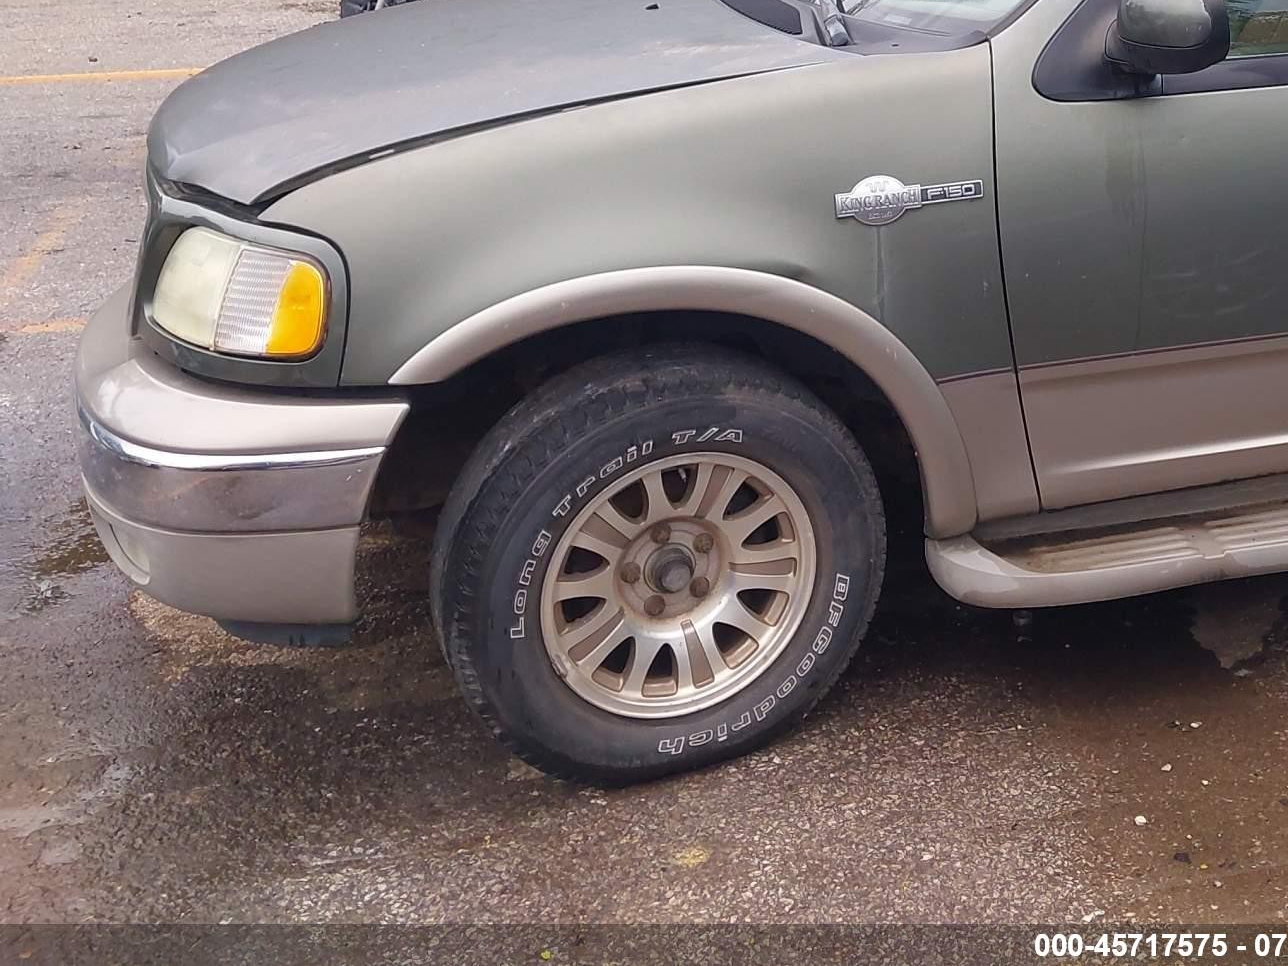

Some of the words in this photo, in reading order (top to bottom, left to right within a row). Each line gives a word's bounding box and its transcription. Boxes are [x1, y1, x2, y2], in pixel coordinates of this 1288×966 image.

[839, 194, 872, 212] KING
[872, 187, 919, 209] RANCH
[926, 183, 975, 201] F-150
[510, 529, 552, 639] Long
[552, 440, 653, 518] Trail
[671, 427, 744, 444] T/A
[657, 573, 850, 755] BFGoodrich
